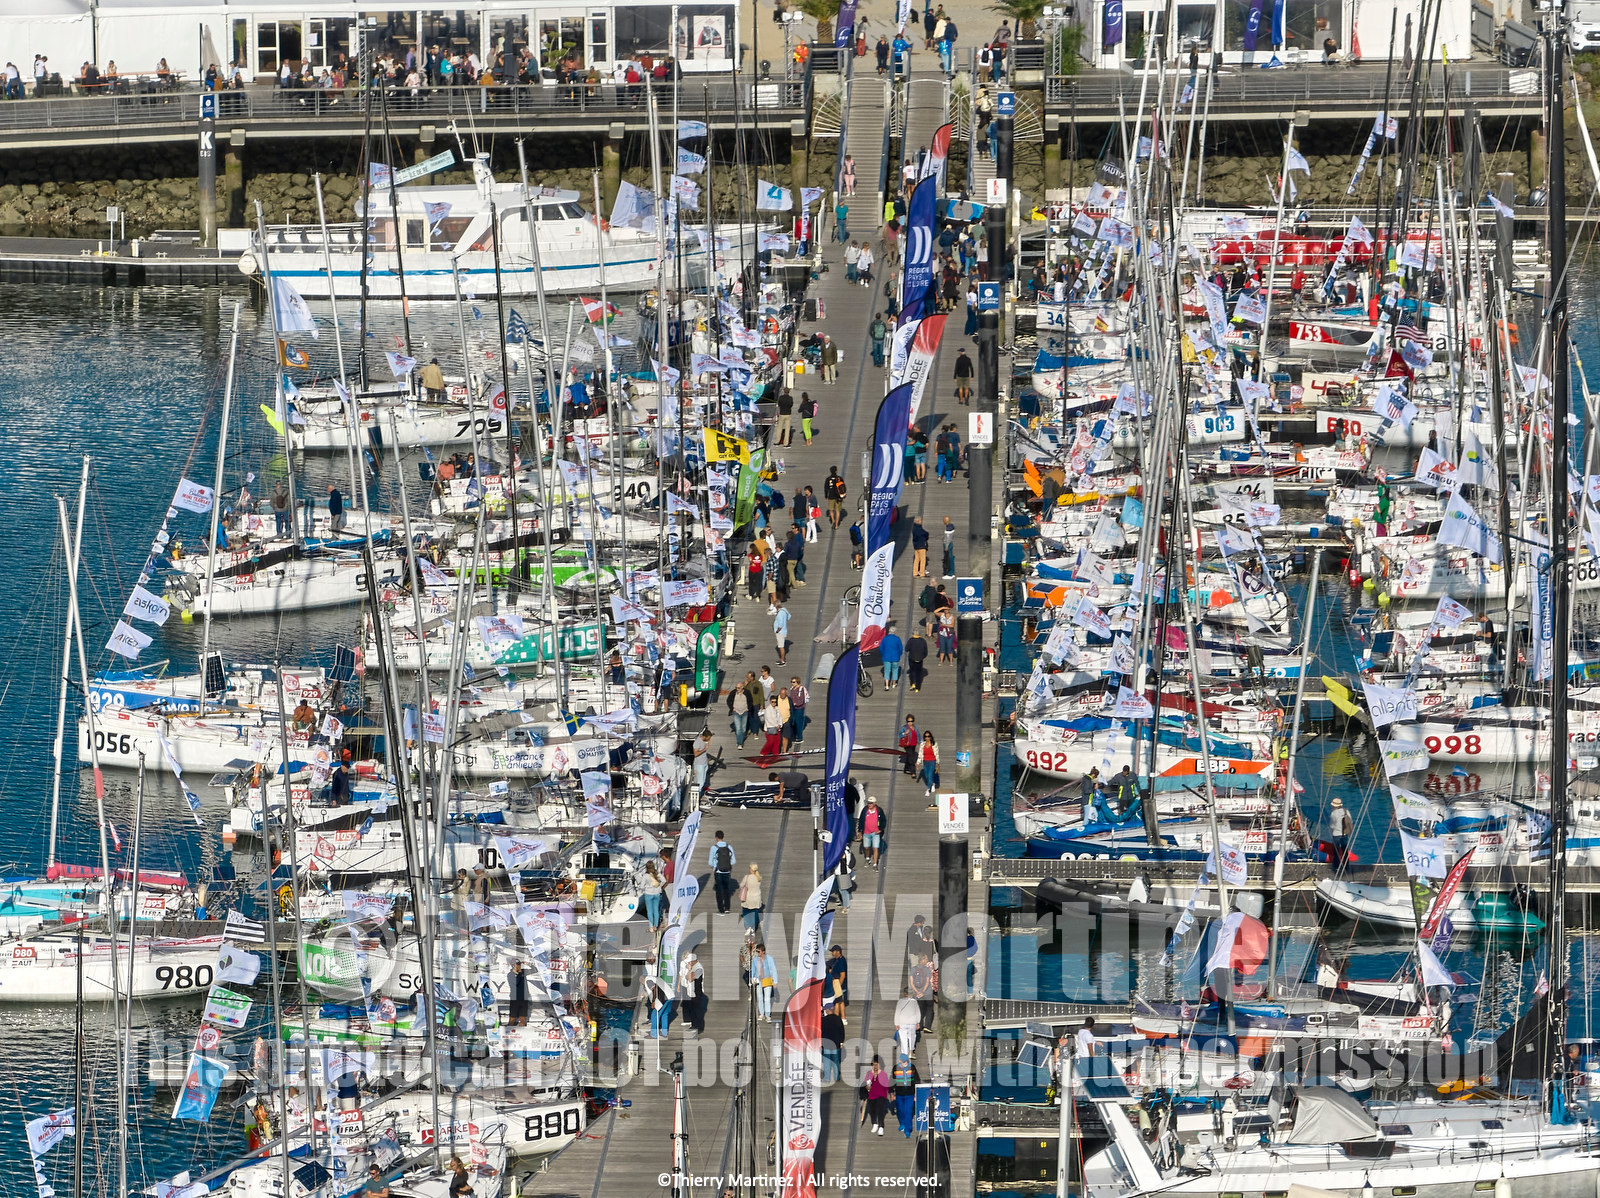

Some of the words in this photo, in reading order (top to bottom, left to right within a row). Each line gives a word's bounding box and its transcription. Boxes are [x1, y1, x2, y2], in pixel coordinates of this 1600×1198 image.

[201, 131, 212, 150] K
[1296, 324, 1322, 342] 753
[1204, 416, 1234, 434] 903
[1427, 471, 1458, 488] TANGUY
[871, 501, 889, 509] PAYS
[236, 574, 249, 584] 947
[356, 568, 394, 592] 97
[864, 552, 886, 618] Boulangère
[134, 598, 168, 617] askorn
[544, 630, 599, 654] 1009
[700, 658, 710, 690] Sarthe
[1425, 696, 1441, 706] 759
[86, 730, 130, 756] 1056
[1424, 734, 1482, 754] 998
[1027, 750, 1068, 772] 992
[1247, 834, 1264, 842] 865
[1407, 852, 1430, 868] aen
[686, 886, 696, 896] 1012
[146, 899, 163, 908] 895
[15, 948, 32, 957] 980
[156, 964, 214, 990] 980
[788, 1060, 806, 1134] VENDÉE
[806, 1062, 814, 1122] DÉPARTEMENT
[344, 1125, 360, 1133] FRA
[524, 1108, 580, 1142] 890
